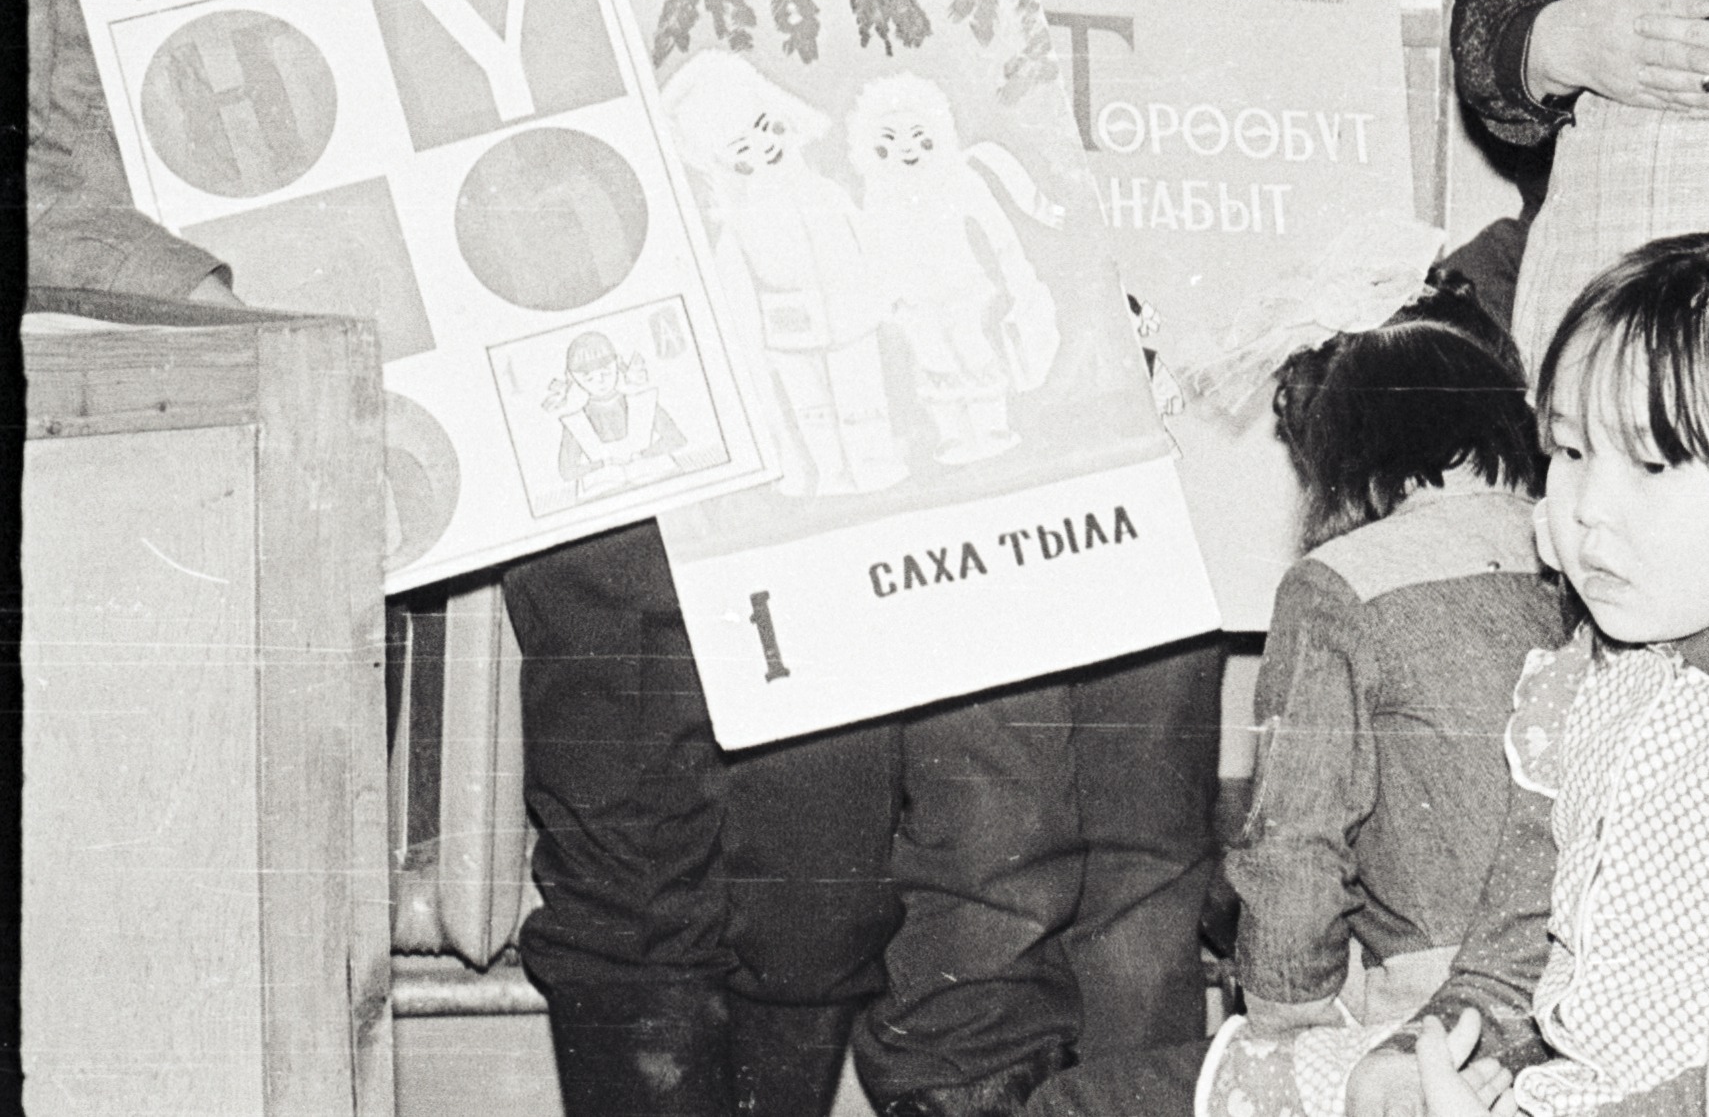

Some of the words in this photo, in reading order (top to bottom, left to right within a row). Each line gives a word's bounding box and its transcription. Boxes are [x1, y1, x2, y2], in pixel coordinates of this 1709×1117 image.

[868, 541, 988, 598] САХА
[998, 505, 1139, 567] ТЫЛА
[749, 590, 791, 683] 1
